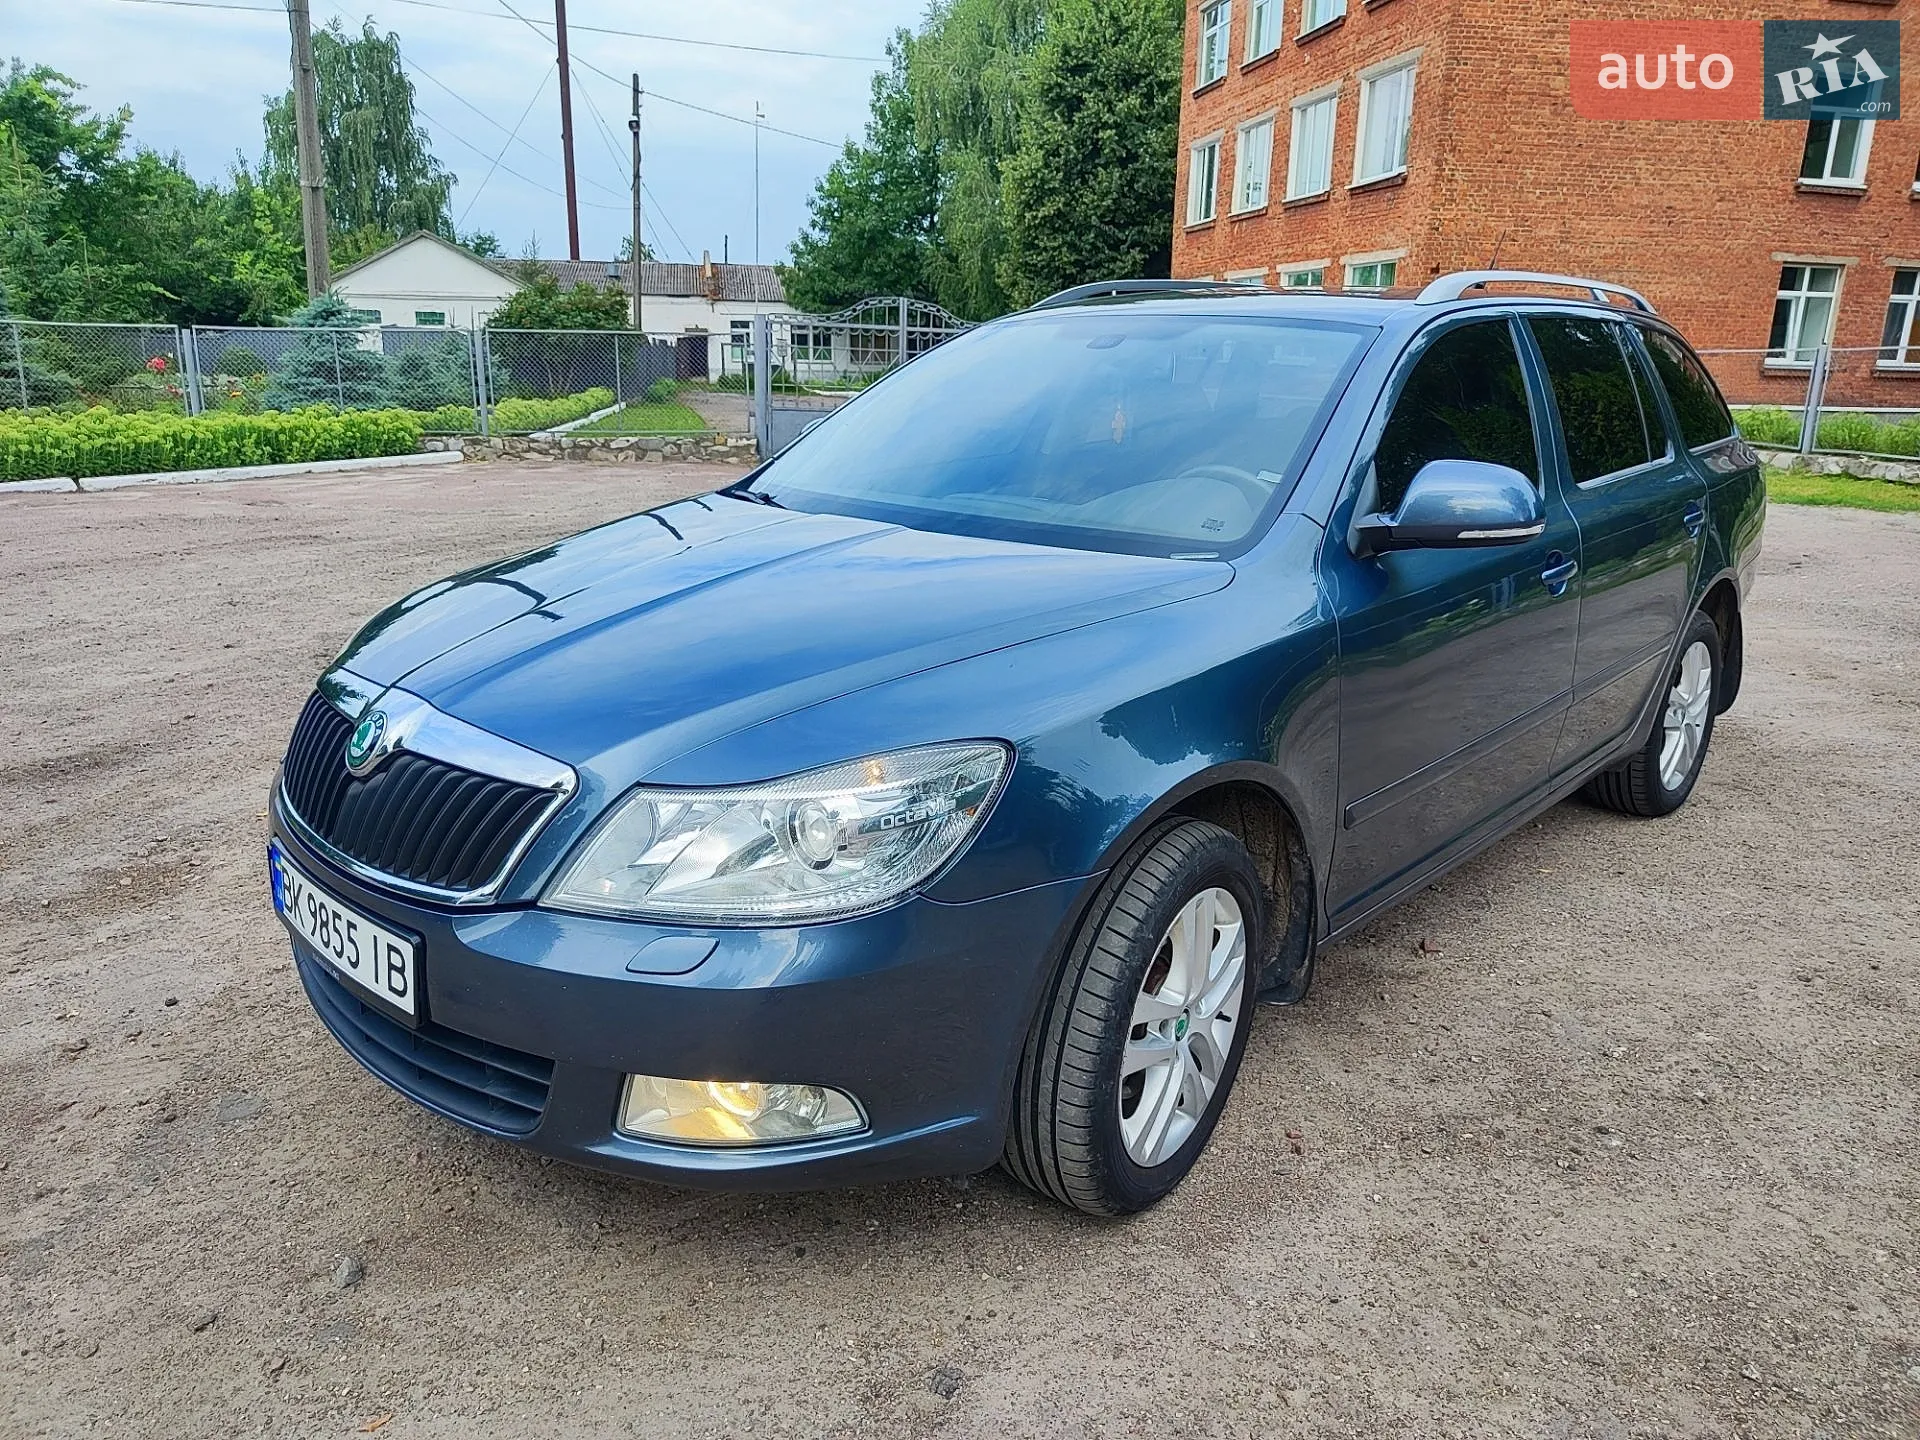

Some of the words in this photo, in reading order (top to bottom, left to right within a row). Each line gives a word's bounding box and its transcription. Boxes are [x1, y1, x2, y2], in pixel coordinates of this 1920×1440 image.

[282, 867, 305, 929] BK
[307, 892, 360, 970] 9855
[373, 934, 408, 998] IB
